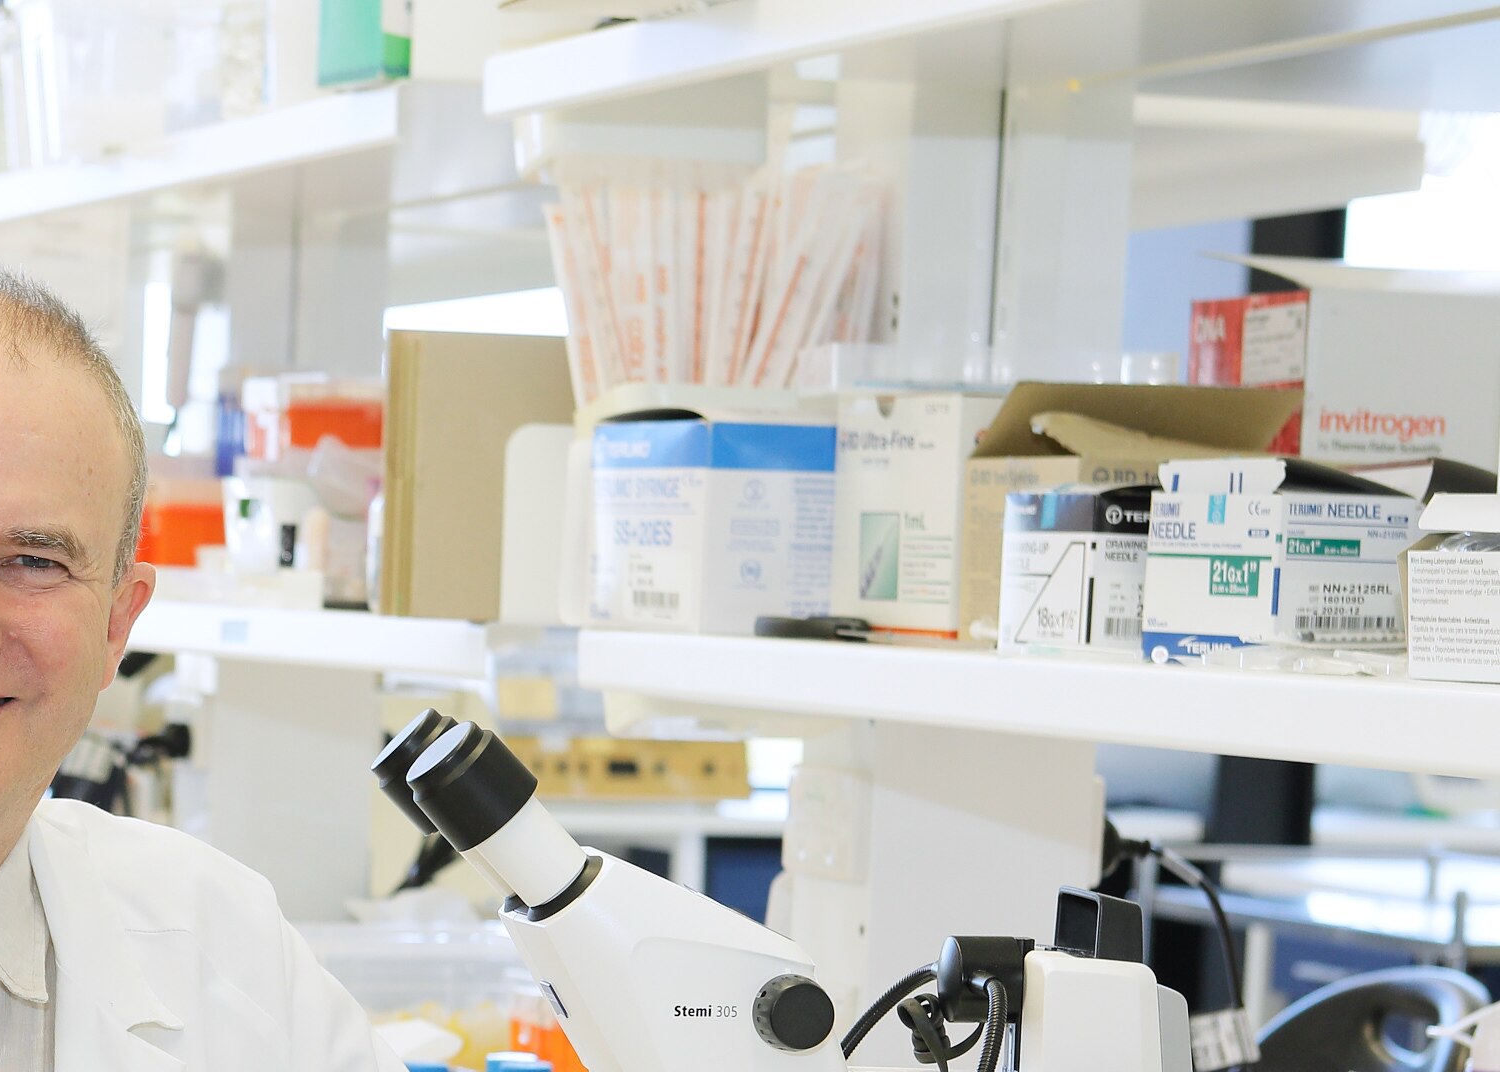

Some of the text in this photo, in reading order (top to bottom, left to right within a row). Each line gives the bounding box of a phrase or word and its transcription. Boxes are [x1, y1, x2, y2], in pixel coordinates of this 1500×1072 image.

[1319, 406, 1445, 441] invitrogen
[861, 428, 916, 450] Ultra-Fine
[1289, 503, 1322, 516] TERUMO
[1327, 503, 1381, 519] NEEDLE
[1152, 522, 1197, 541] NEEDLE
[1105, 539, 1148, 551] DRAWING
[1104, 551, 1139, 563] NEEDLE
[1322, 583, 1393, 595] NN+2125RL
[1322, 607, 1360, 616] 2020-12
[673, 1004, 738, 1018] Stemi 305
